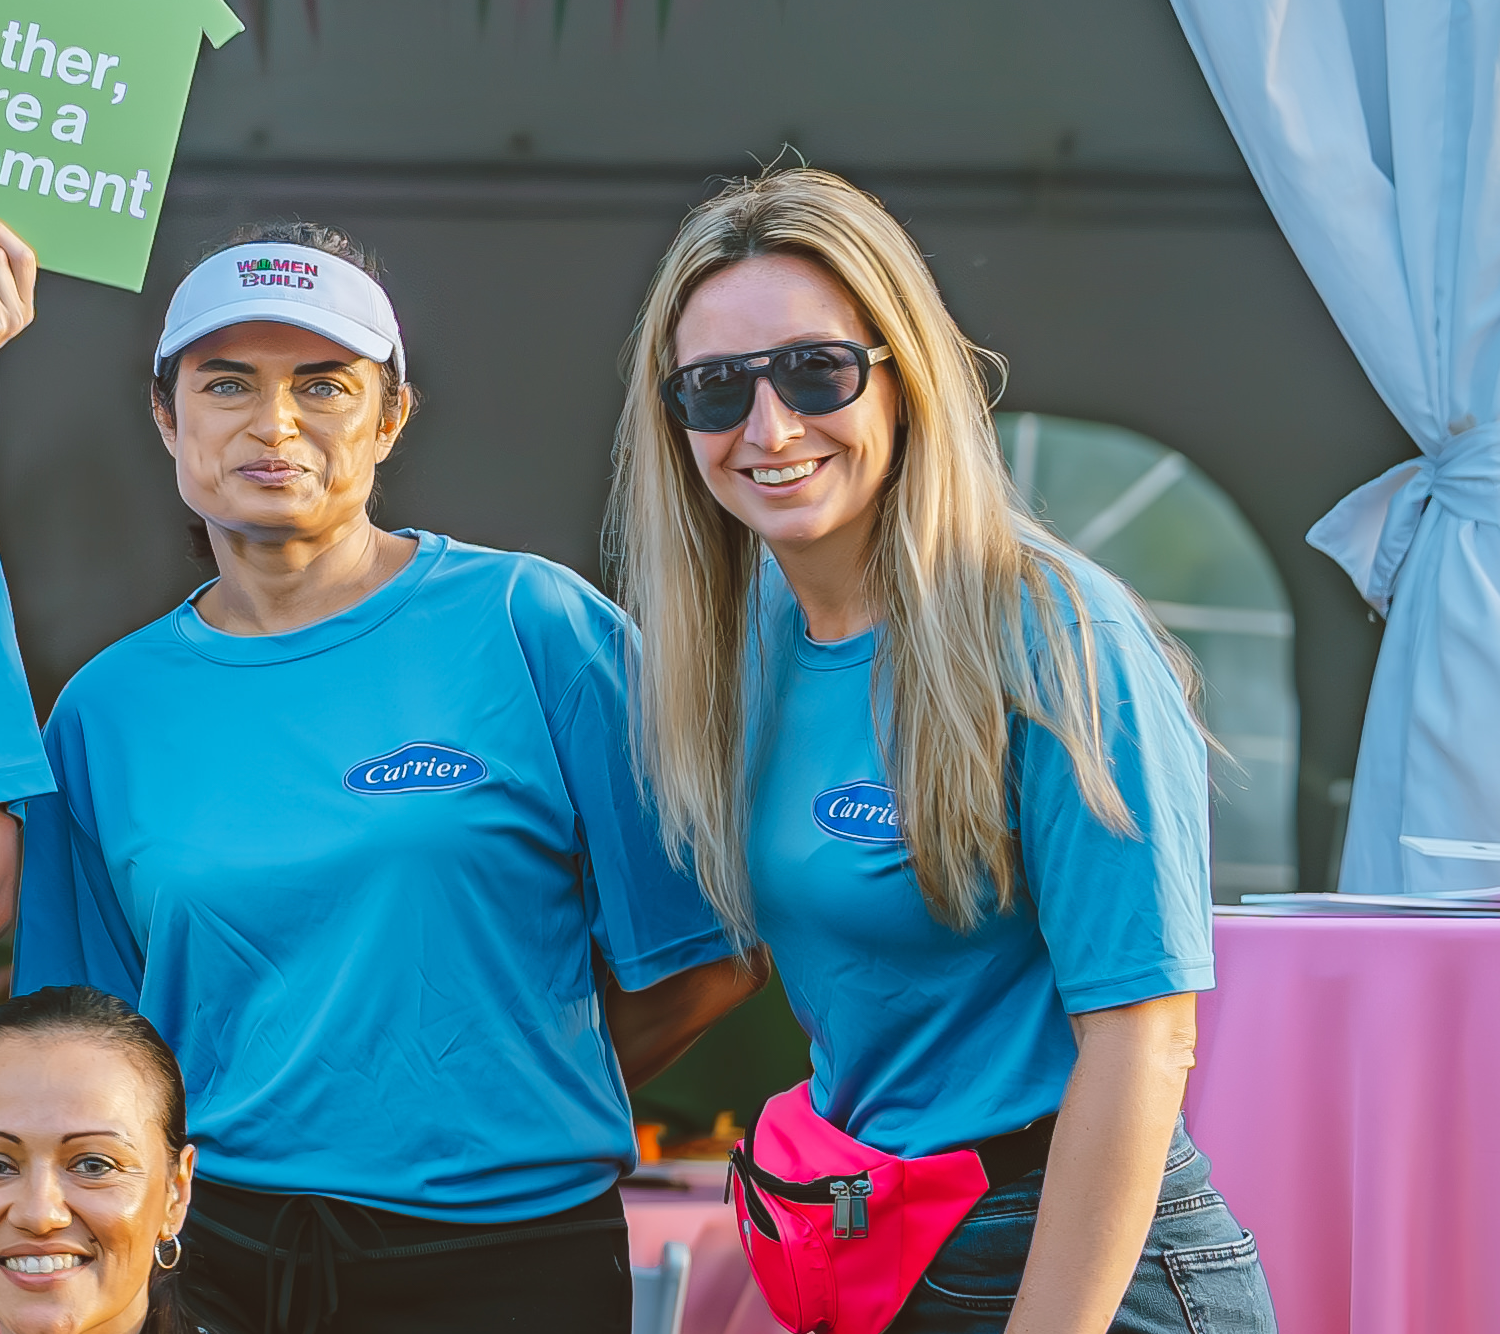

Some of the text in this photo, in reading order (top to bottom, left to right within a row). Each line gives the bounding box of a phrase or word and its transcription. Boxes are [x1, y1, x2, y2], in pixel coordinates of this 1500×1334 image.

[50, 103, 89, 145] a
[236, 258, 319, 277] WOMEN
[241, 273, 315, 290] BUILD
[364, 756, 468, 785] Carrier
[828, 795, 908, 827] Carrie
